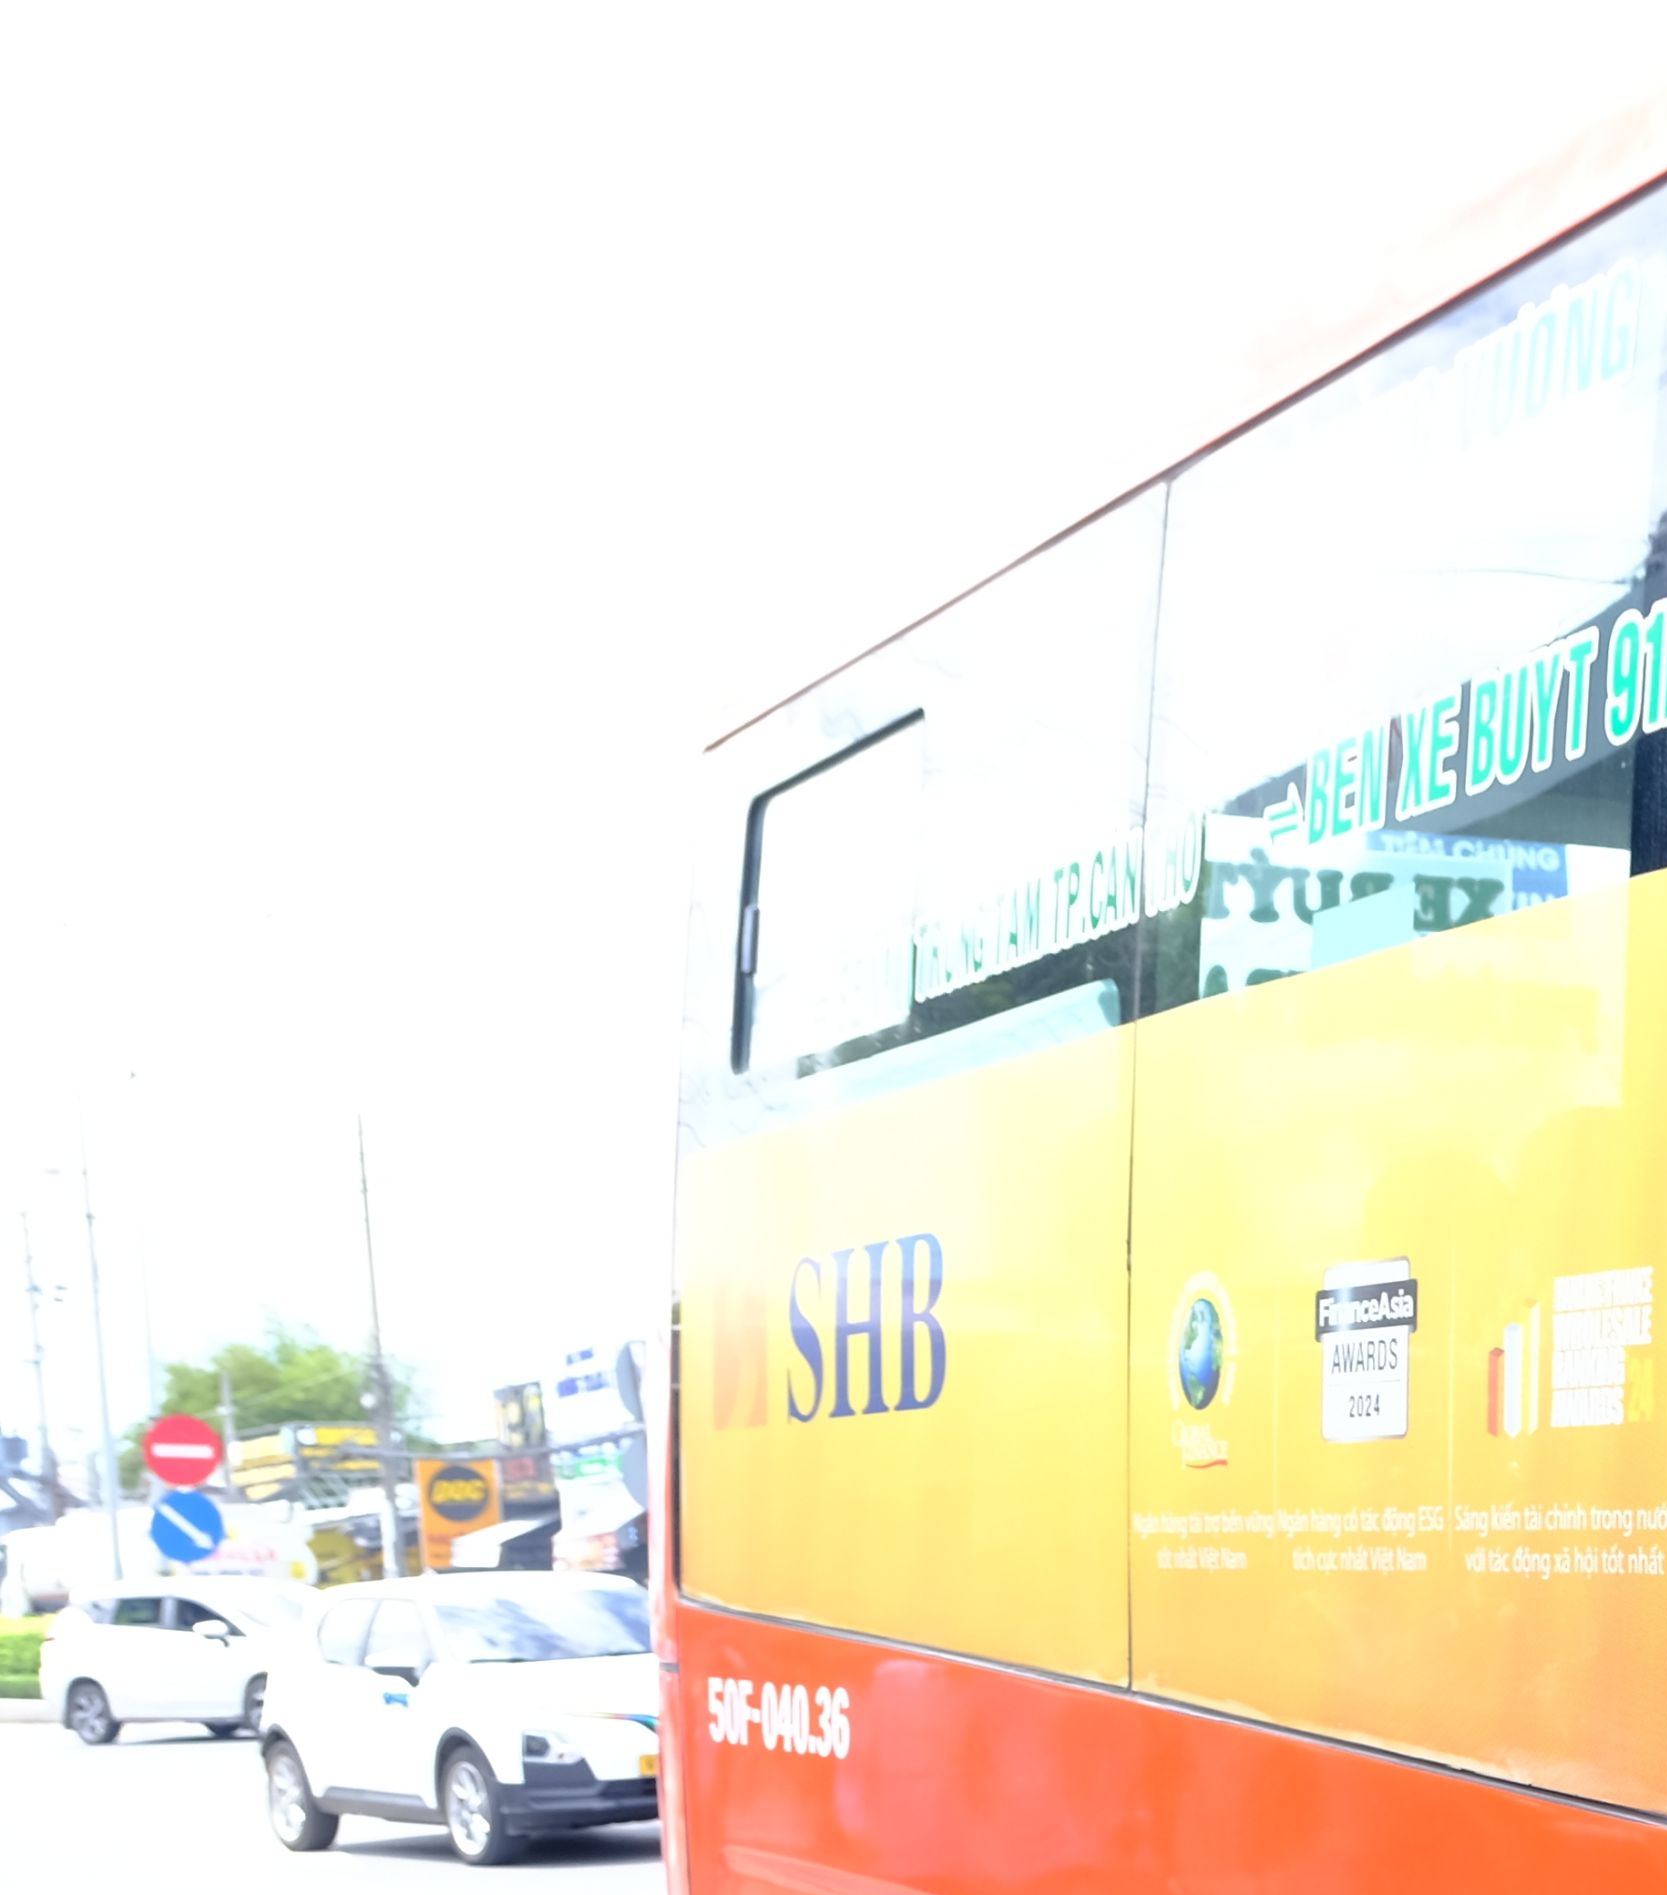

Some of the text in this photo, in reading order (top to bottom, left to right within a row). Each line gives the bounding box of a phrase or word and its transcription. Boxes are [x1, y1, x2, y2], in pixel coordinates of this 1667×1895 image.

[1397, 688, 1462, 820] XE
[1318, 1288, 1415, 1328] FinanceAsia
[786, 1231, 947, 1425] SHB
[1331, 1337, 1399, 1375] AWARDS
[1348, 1393, 1381, 1418] 2024
[1417, 1505, 1445, 1532] ESG
[1589, 1506, 1633, 1537] trong
[706, 1677, 851, 1761] 50F-040.36
